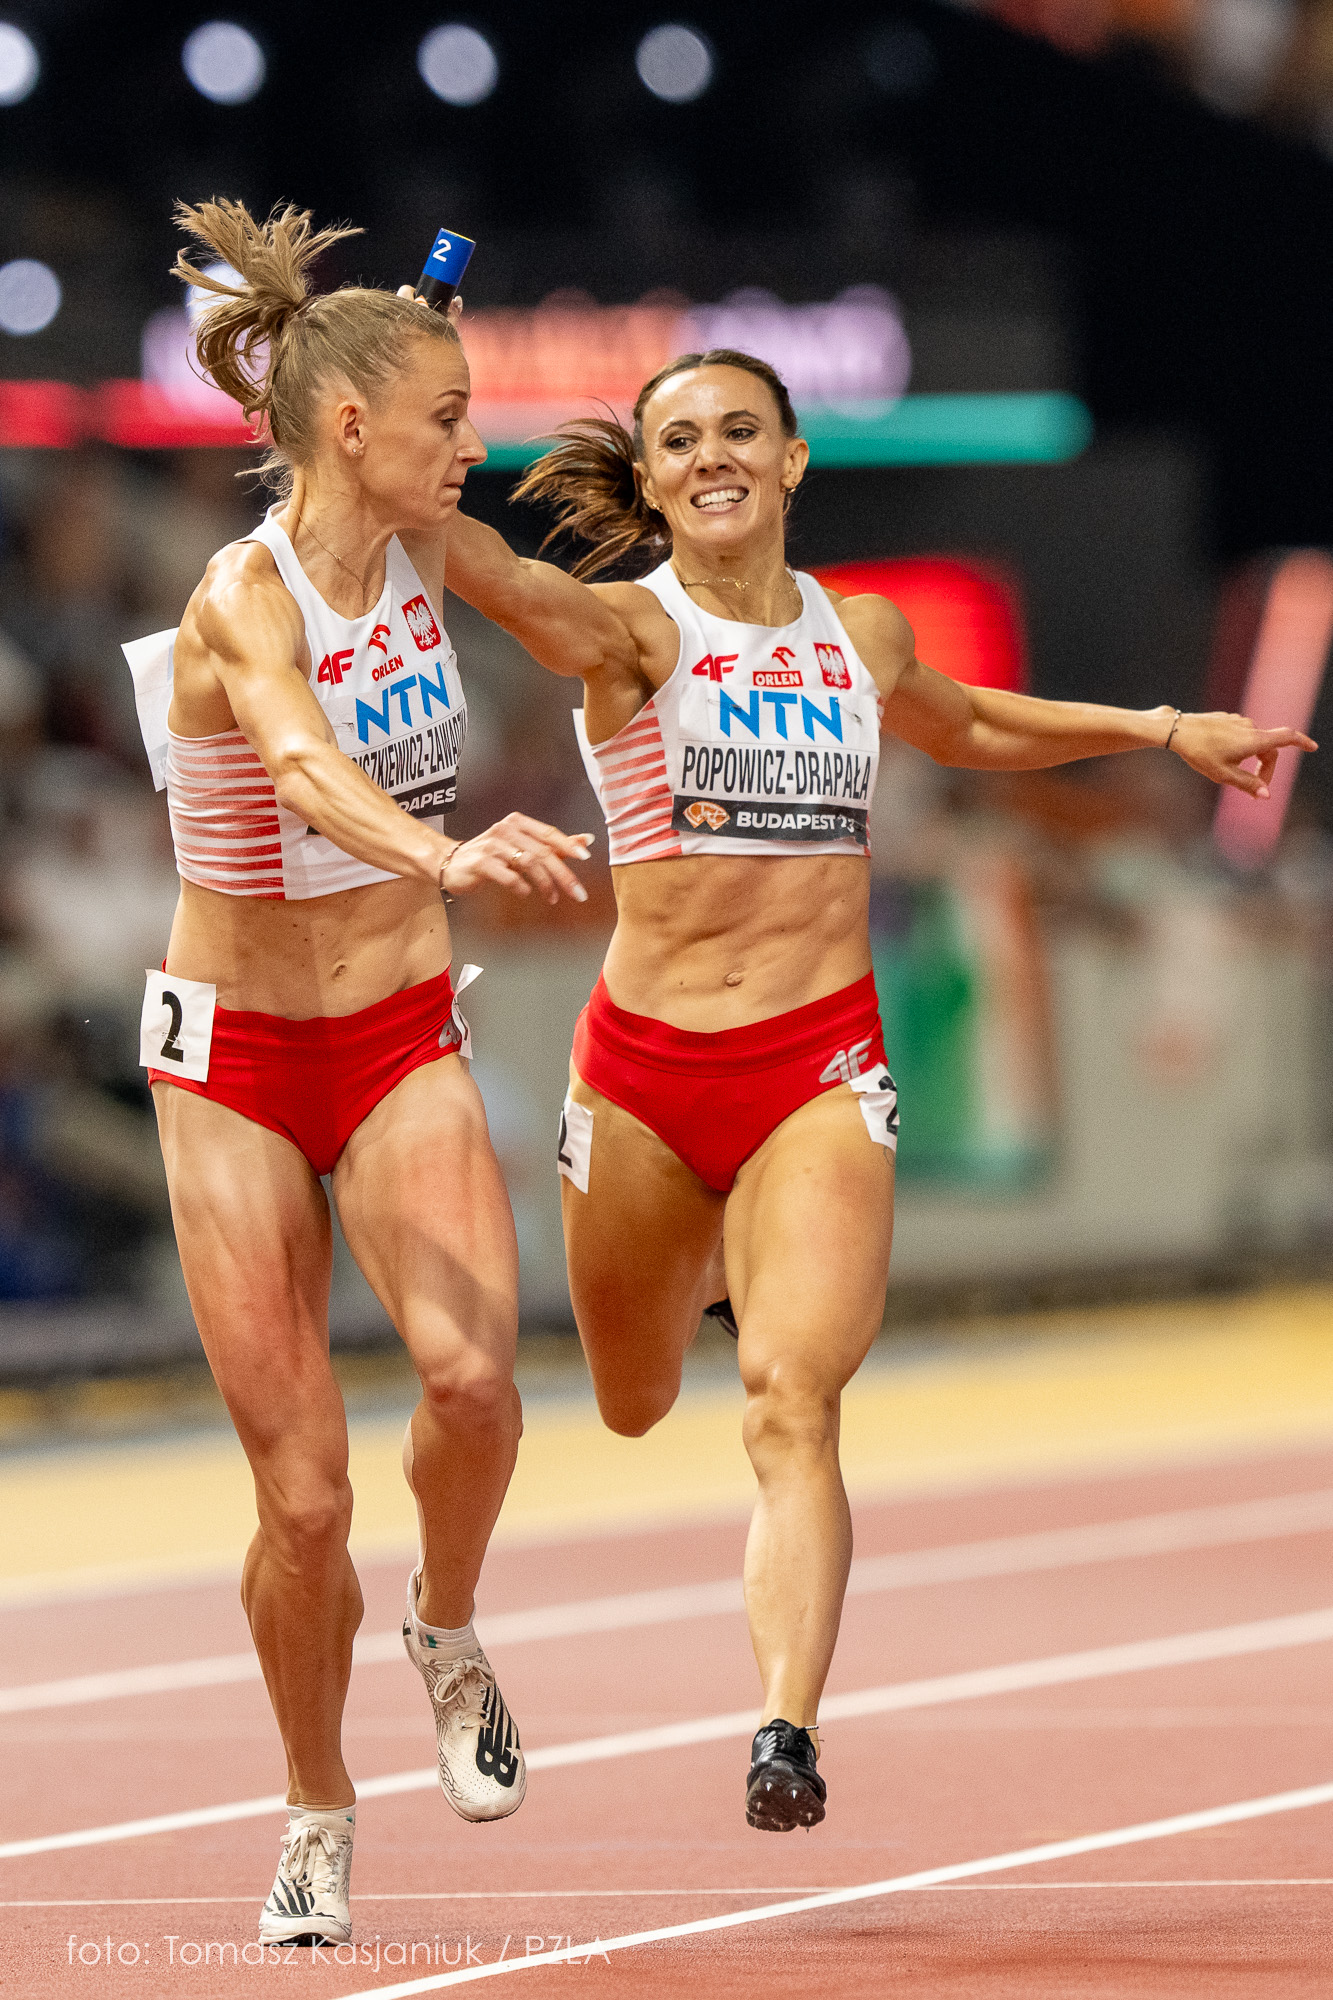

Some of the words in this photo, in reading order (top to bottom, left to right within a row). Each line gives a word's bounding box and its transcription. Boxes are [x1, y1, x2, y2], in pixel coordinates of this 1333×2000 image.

[432, 238, 452, 263] 2
[317, 648, 355, 685] 4F
[371, 654, 405, 682] ORLEN
[691, 653, 739, 683] 4F
[755, 672, 801, 687] ORLEN
[355, 661, 451, 745] NTN
[719, 688, 844, 745] NTN
[681, 745, 872, 801] POPOWICZ-DRAPAŁA
[397, 786, 457, 813] DAPES
[736, 811, 836, 830] BUDAPEST
[160, 990, 184, 1063] 2
[819, 1037, 873, 1083] 4F
